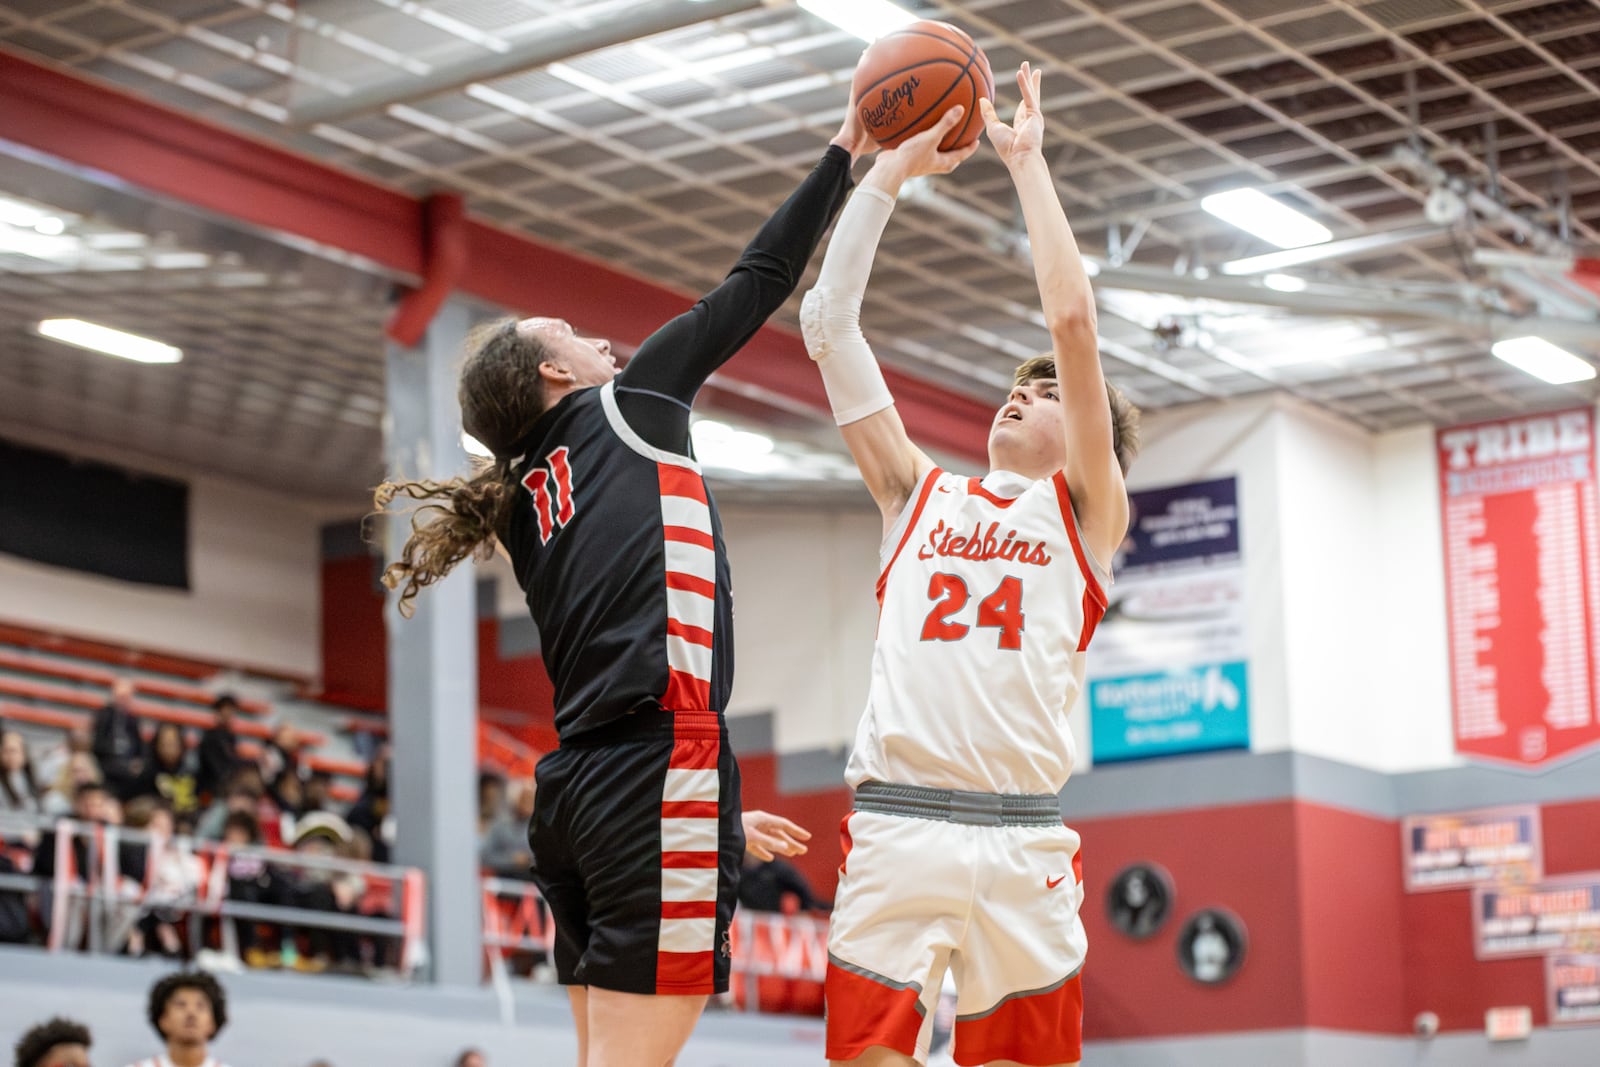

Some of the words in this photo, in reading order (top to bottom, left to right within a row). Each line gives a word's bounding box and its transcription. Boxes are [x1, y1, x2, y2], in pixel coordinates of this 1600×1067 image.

[861, 75, 920, 134] Rawlings
[1442, 412, 1589, 469] TRIBE
[521, 446, 576, 547] 11
[918, 519, 1052, 566] Stebbins
[920, 571, 1025, 651] 24
